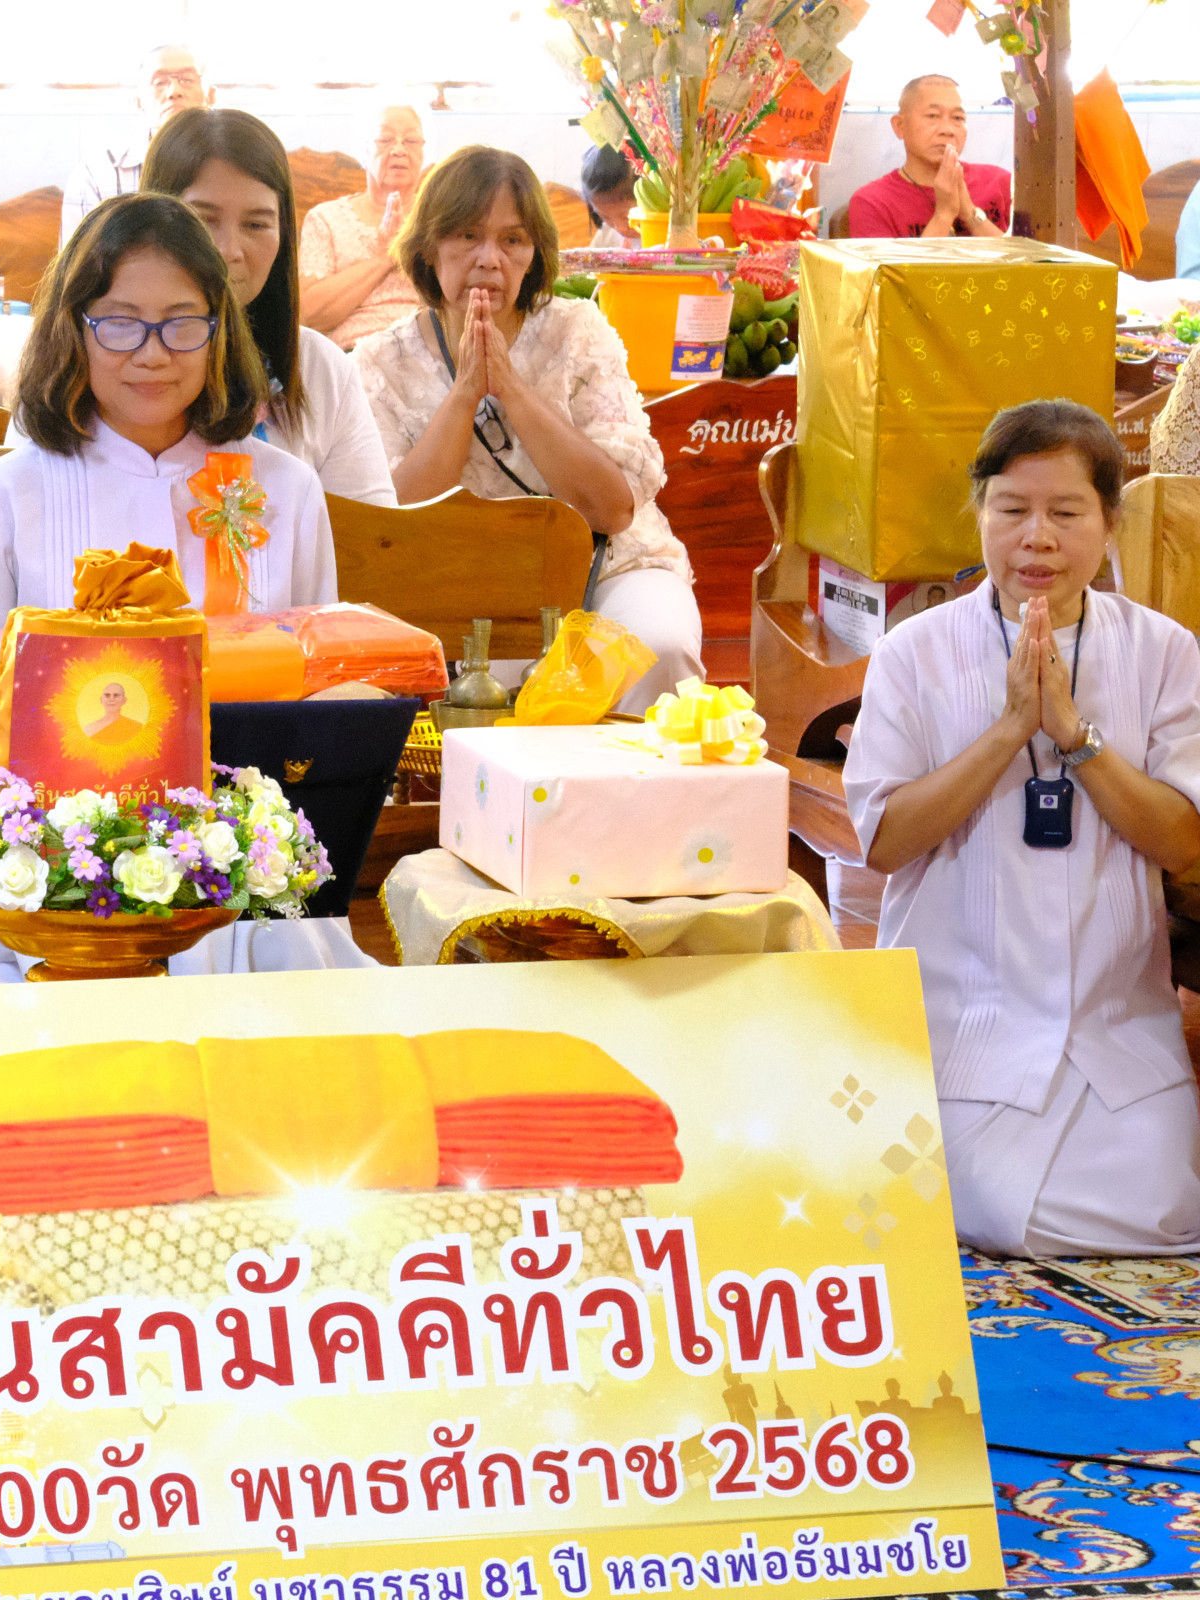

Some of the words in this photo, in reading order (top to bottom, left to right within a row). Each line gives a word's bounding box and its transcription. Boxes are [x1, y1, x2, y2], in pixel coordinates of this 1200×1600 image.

[230, 1422, 678, 1552] พุทธศักราช
[708, 1419, 910, 1494] 2568
[253, 1570, 465, 1600] บชาธรรม
[484, 1560, 539, 1599] 81
[553, 1545, 588, 1595] ปี
[606, 1521, 968, 1591] หลวงพ่อธัมมชโย
